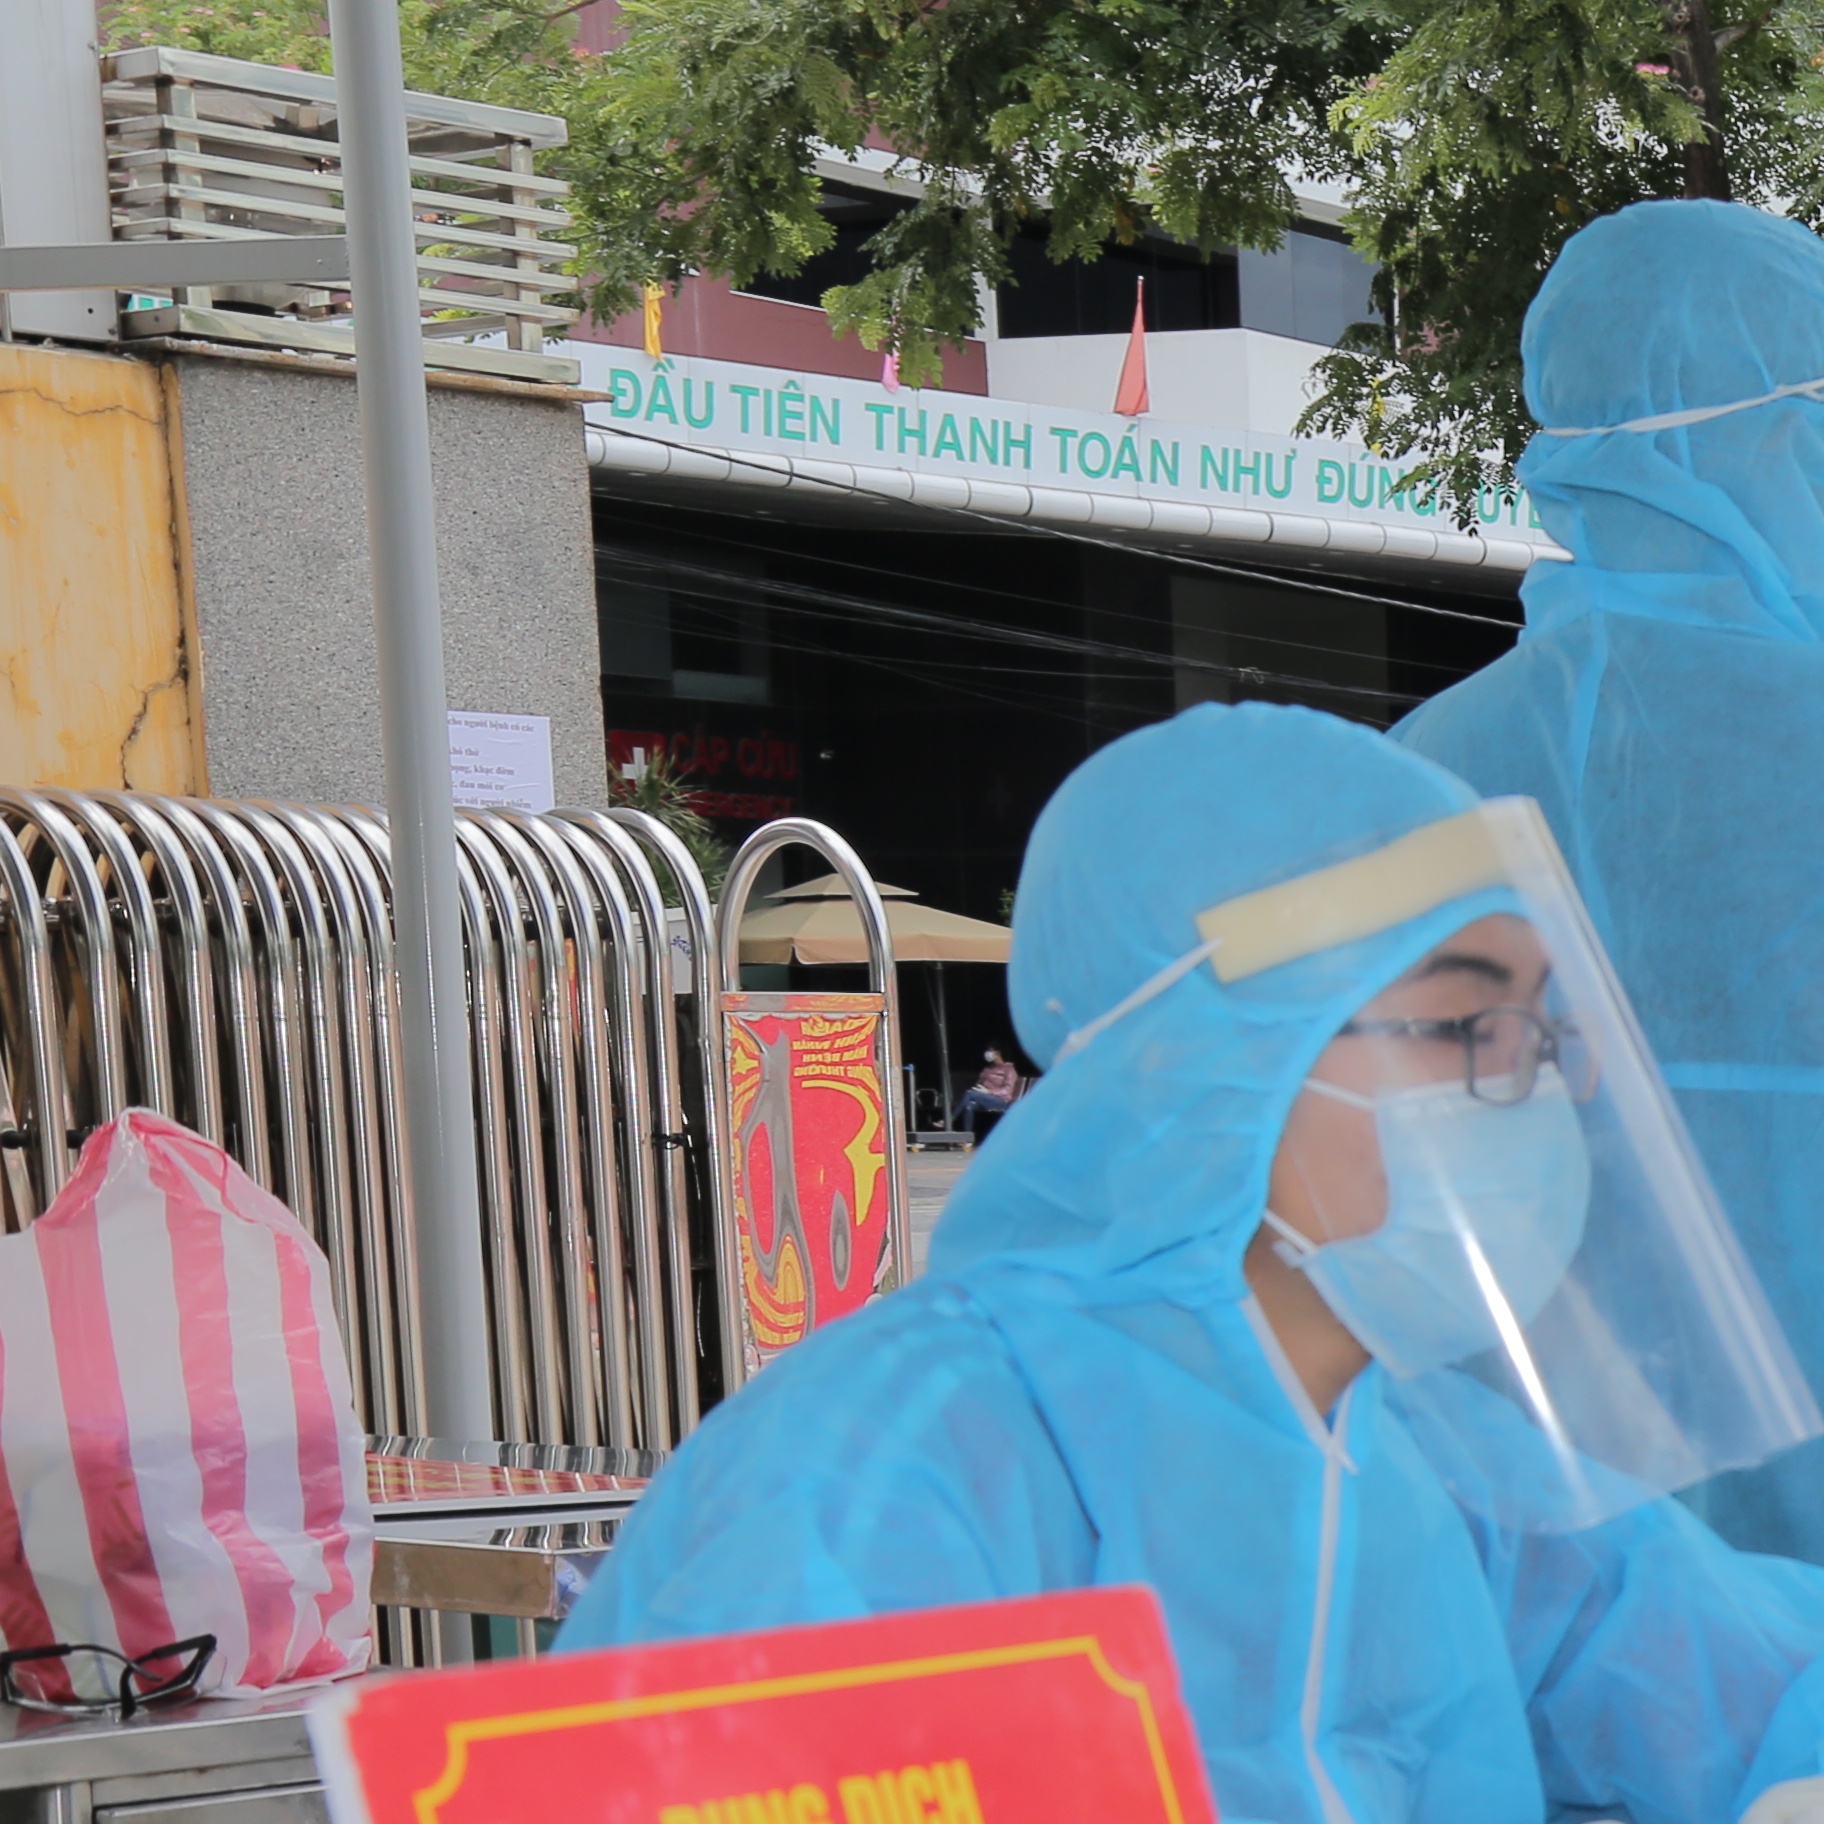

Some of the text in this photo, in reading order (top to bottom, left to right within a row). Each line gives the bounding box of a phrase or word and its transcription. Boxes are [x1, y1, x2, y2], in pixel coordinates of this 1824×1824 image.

[609, 357, 714, 428] ĐẦU
[731, 379, 840, 444] TIÊN
[865, 403, 1031, 468] THANH
[1050, 424, 1179, 485] TOÁN
[1201, 446, 1298, 498] NHƯ
